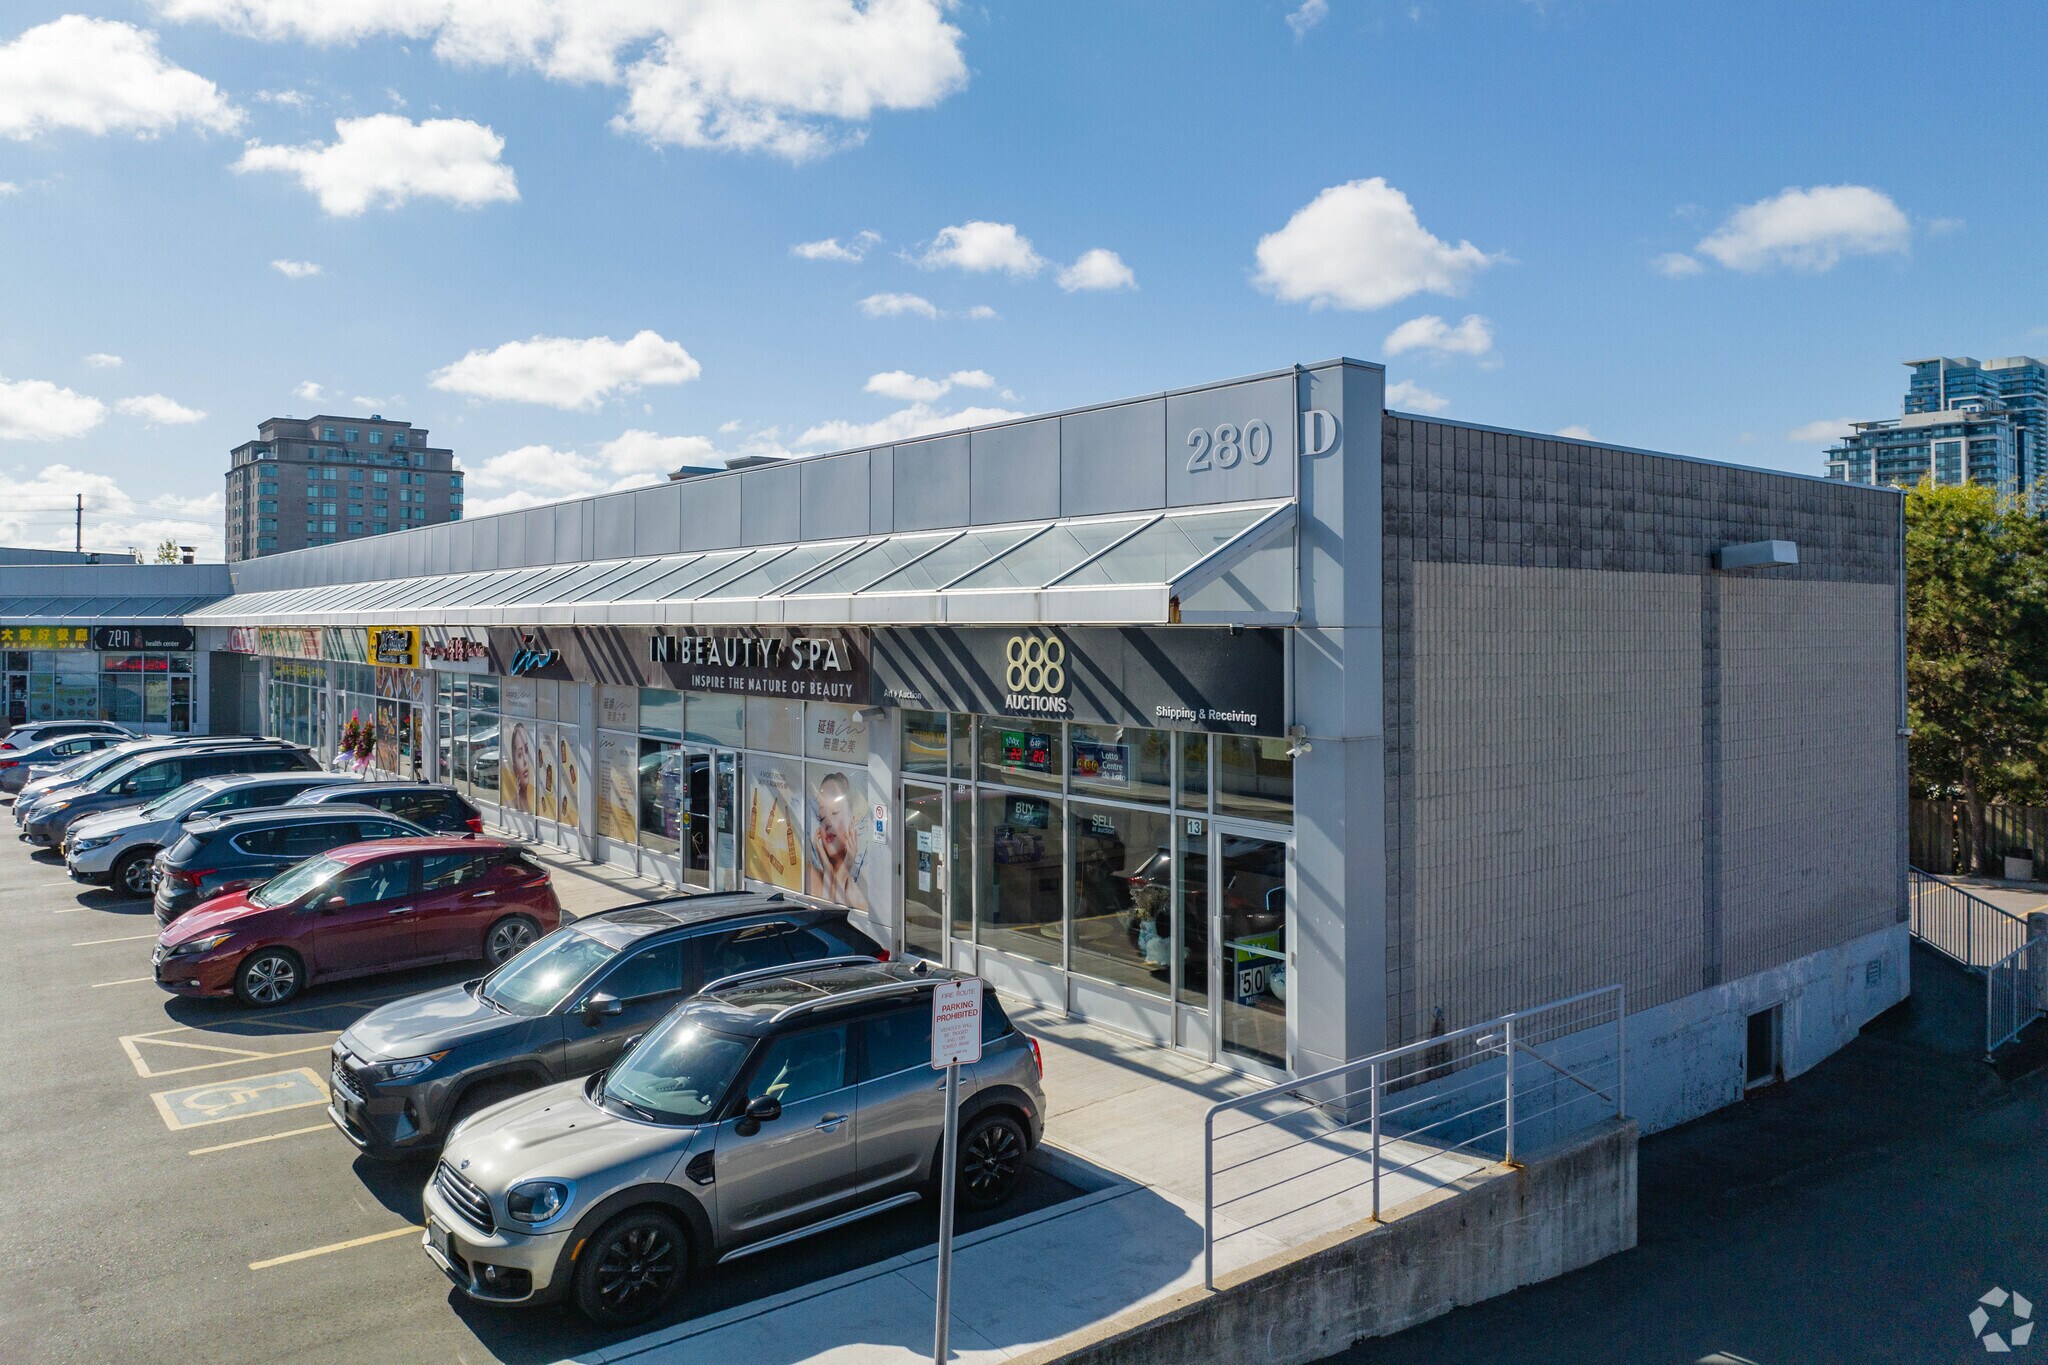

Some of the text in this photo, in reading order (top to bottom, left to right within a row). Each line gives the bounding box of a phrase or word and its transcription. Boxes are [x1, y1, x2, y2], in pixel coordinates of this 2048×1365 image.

[1300, 409, 1337, 457] D
[1186, 418, 1270, 472] 280
[681, 636, 774, 669] BEAUTY
[791, 638, 841, 672] SPA
[1006, 636, 1066, 694] 888
[692, 674, 852, 698] INSPIRE THE NATURE OF BEAUTY
[884, 688, 892, 698] Art
[1005, 694, 1068, 712] AUCTIONS
[1156, 705, 1257, 726] Shipping & Receiving
[1010, 748, 1022, 760] 22
[1032, 750, 1045, 763] 20
[1101, 751, 1118, 760] Lotto
[1102, 761, 1123, 771] Centre
[1102, 771, 1126, 781] de Loto
[1016, 802, 1034, 815] BUY
[1092, 814, 1115, 828] SELL
[1189, 820, 1200, 833] 13
[956, 988, 975, 997] ROUTE
[942, 1000, 973, 1012] PARKING
[936, 1008, 978, 1022] PROHIBITED
